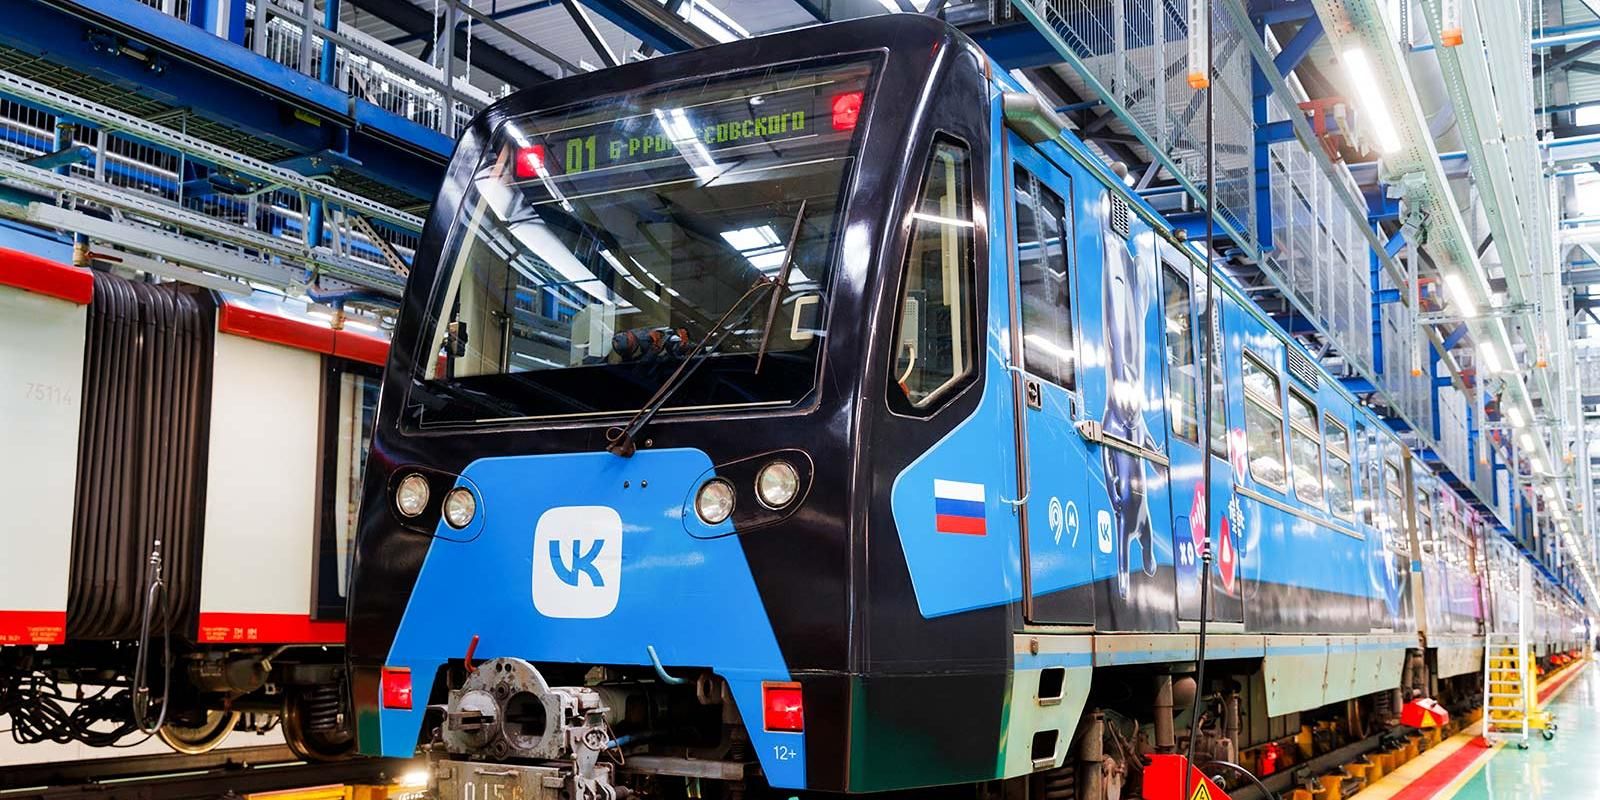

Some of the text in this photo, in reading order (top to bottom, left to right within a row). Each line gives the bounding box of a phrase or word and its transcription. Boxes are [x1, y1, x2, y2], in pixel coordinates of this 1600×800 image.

[566, 136, 596, 175] 01
[25, 383, 72, 406] 75114
[549, 539, 605, 587] VK
[773, 745, 797, 760] 12+
